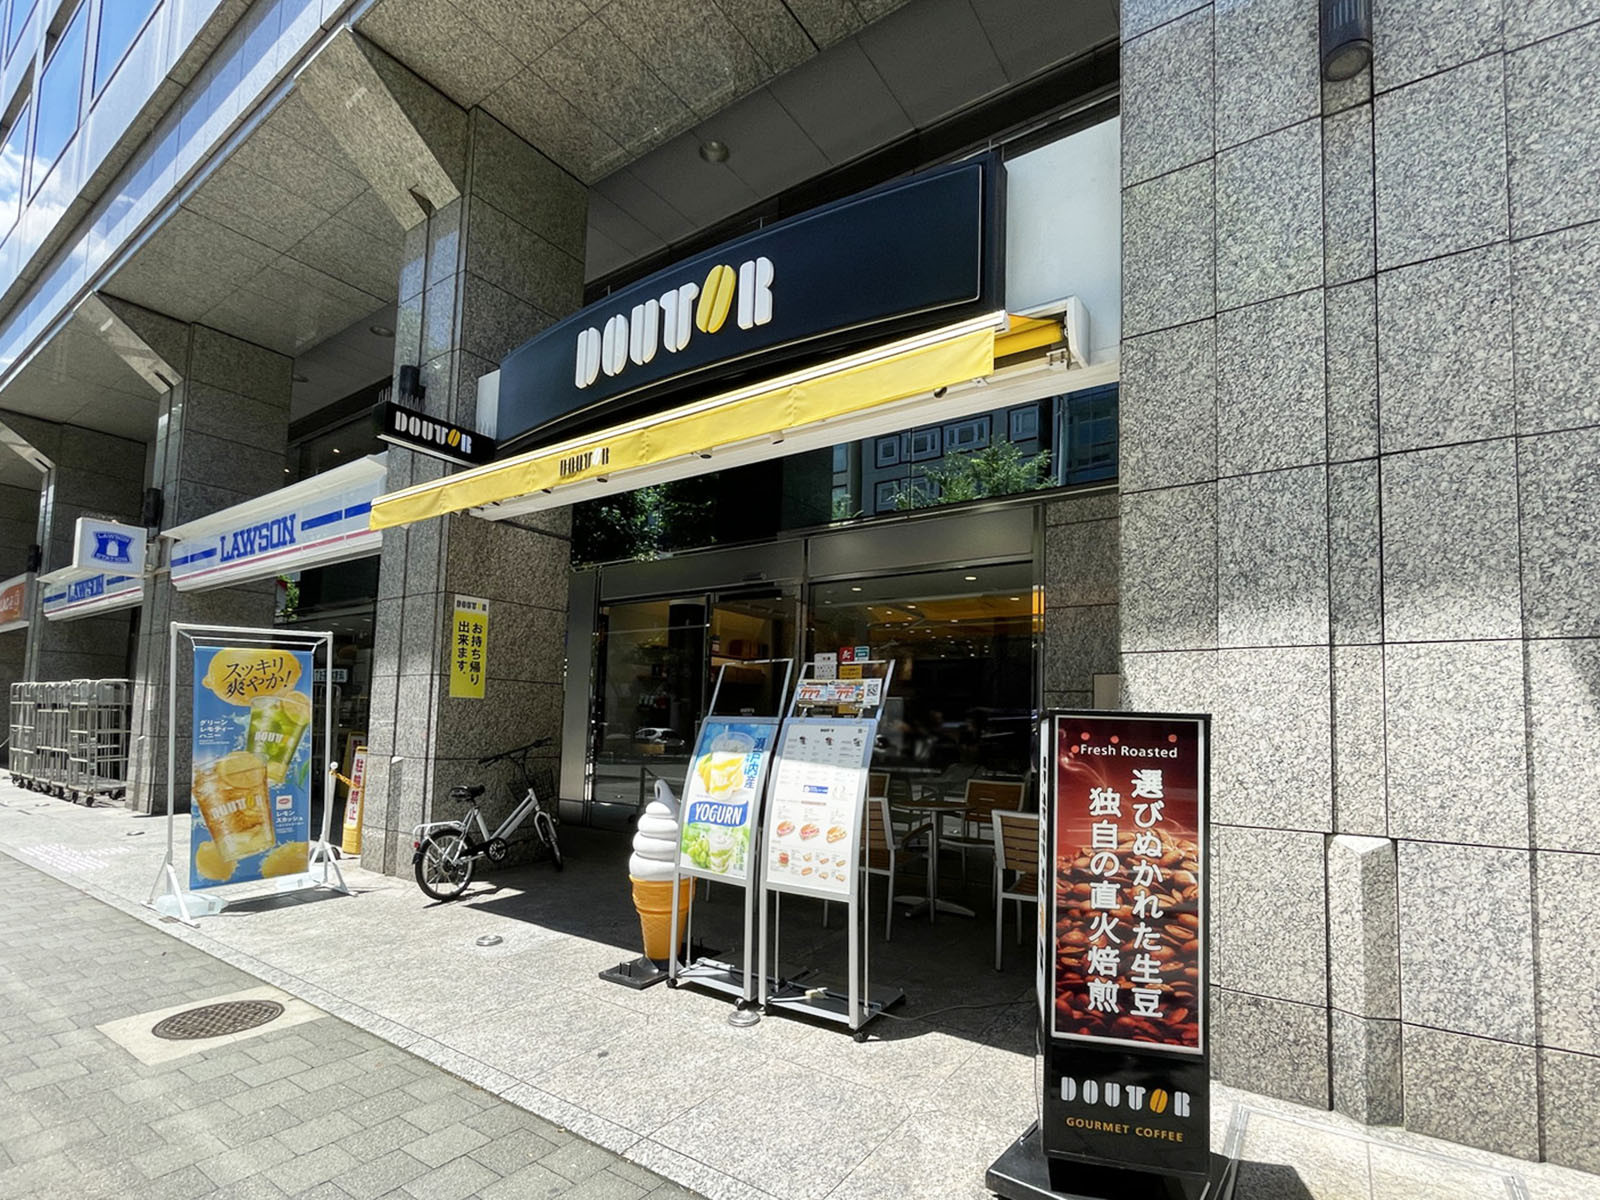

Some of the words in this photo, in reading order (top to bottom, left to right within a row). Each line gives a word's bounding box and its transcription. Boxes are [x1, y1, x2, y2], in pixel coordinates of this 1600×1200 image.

[574, 256, 774, 389] DOUTOR
[395, 410, 472, 454] DOUTOR
[560, 447, 609, 476] DOUTOR
[220, 513, 296, 562] LAWSON
[223, 657, 284, 681] スッキリ
[469, 622, 484, 686] お持ち帰り
[1080, 744, 1116, 756] Fresh
[1121, 745, 1178, 758] Roasted
[694, 803, 743, 825] YOGURN
[1087, 787, 1121, 1014] 独自の直火焙煎
[1130, 769, 1164, 1019] 選びぬかれた生豆
[1061, 1076, 1190, 1117] DOUTOR
[1066, 1117, 1130, 1134] GOURMET
[1135, 1127, 1184, 1142] COFFEE
